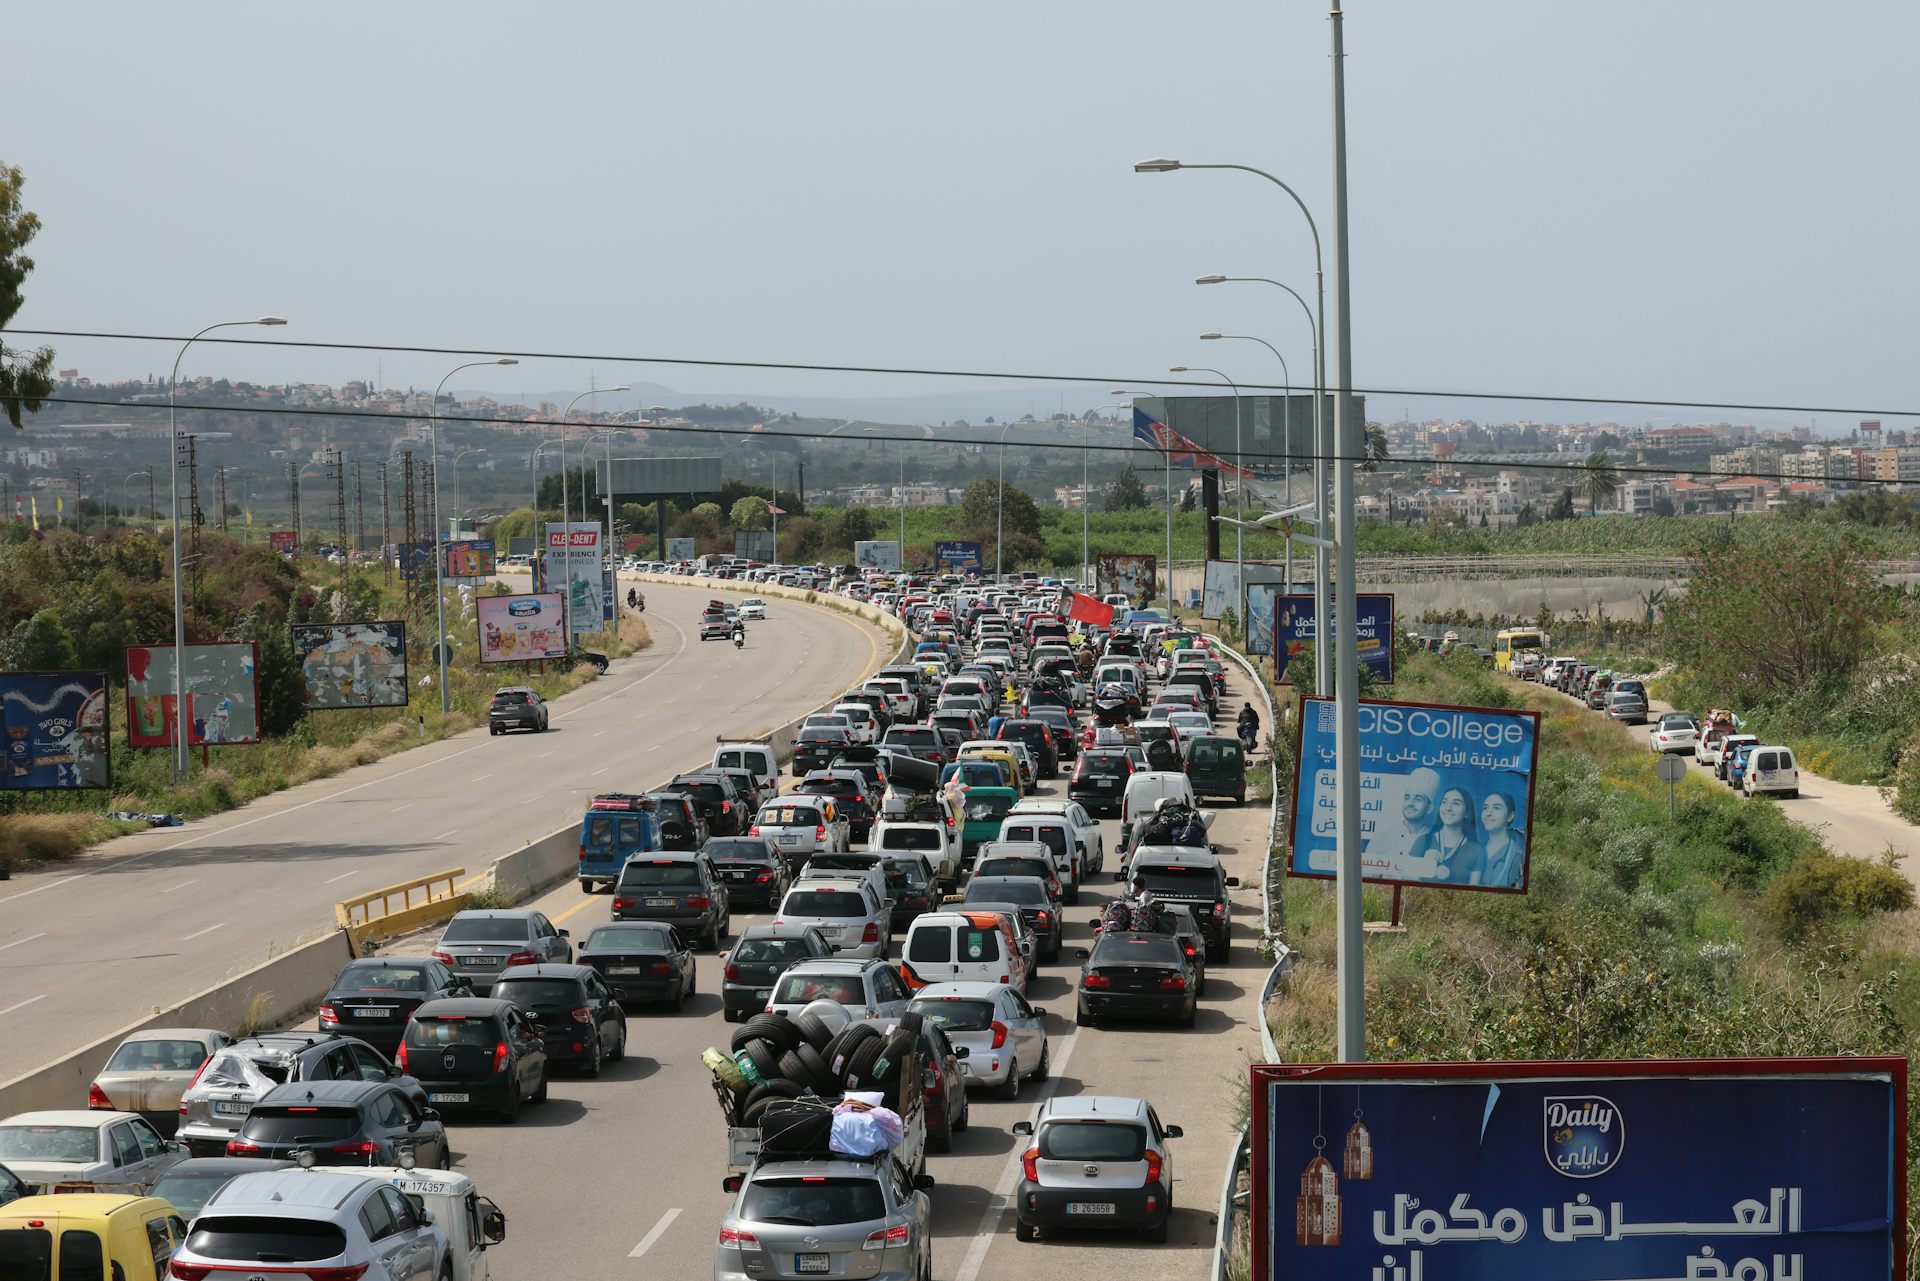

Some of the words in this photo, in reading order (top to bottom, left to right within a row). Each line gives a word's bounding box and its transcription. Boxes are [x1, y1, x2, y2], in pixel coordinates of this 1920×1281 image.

[1358, 707, 1404, 734] CIS
[1408, 711, 1523, 748] College
[1360, 745, 1383, 760] لبنا
[1386, 747, 1418, 762] على
[1422, 747, 1466, 768] الأولى
[1470, 752, 1520, 770] المرتبة
[1547, 1102, 1613, 1133] Daily
[1557, 1146, 1609, 1169] دايلي
[400, 1181, 406, 1190] M
[412, 1182, 445, 1193] 174357
[1072, 1204, 1078, 1213] B
